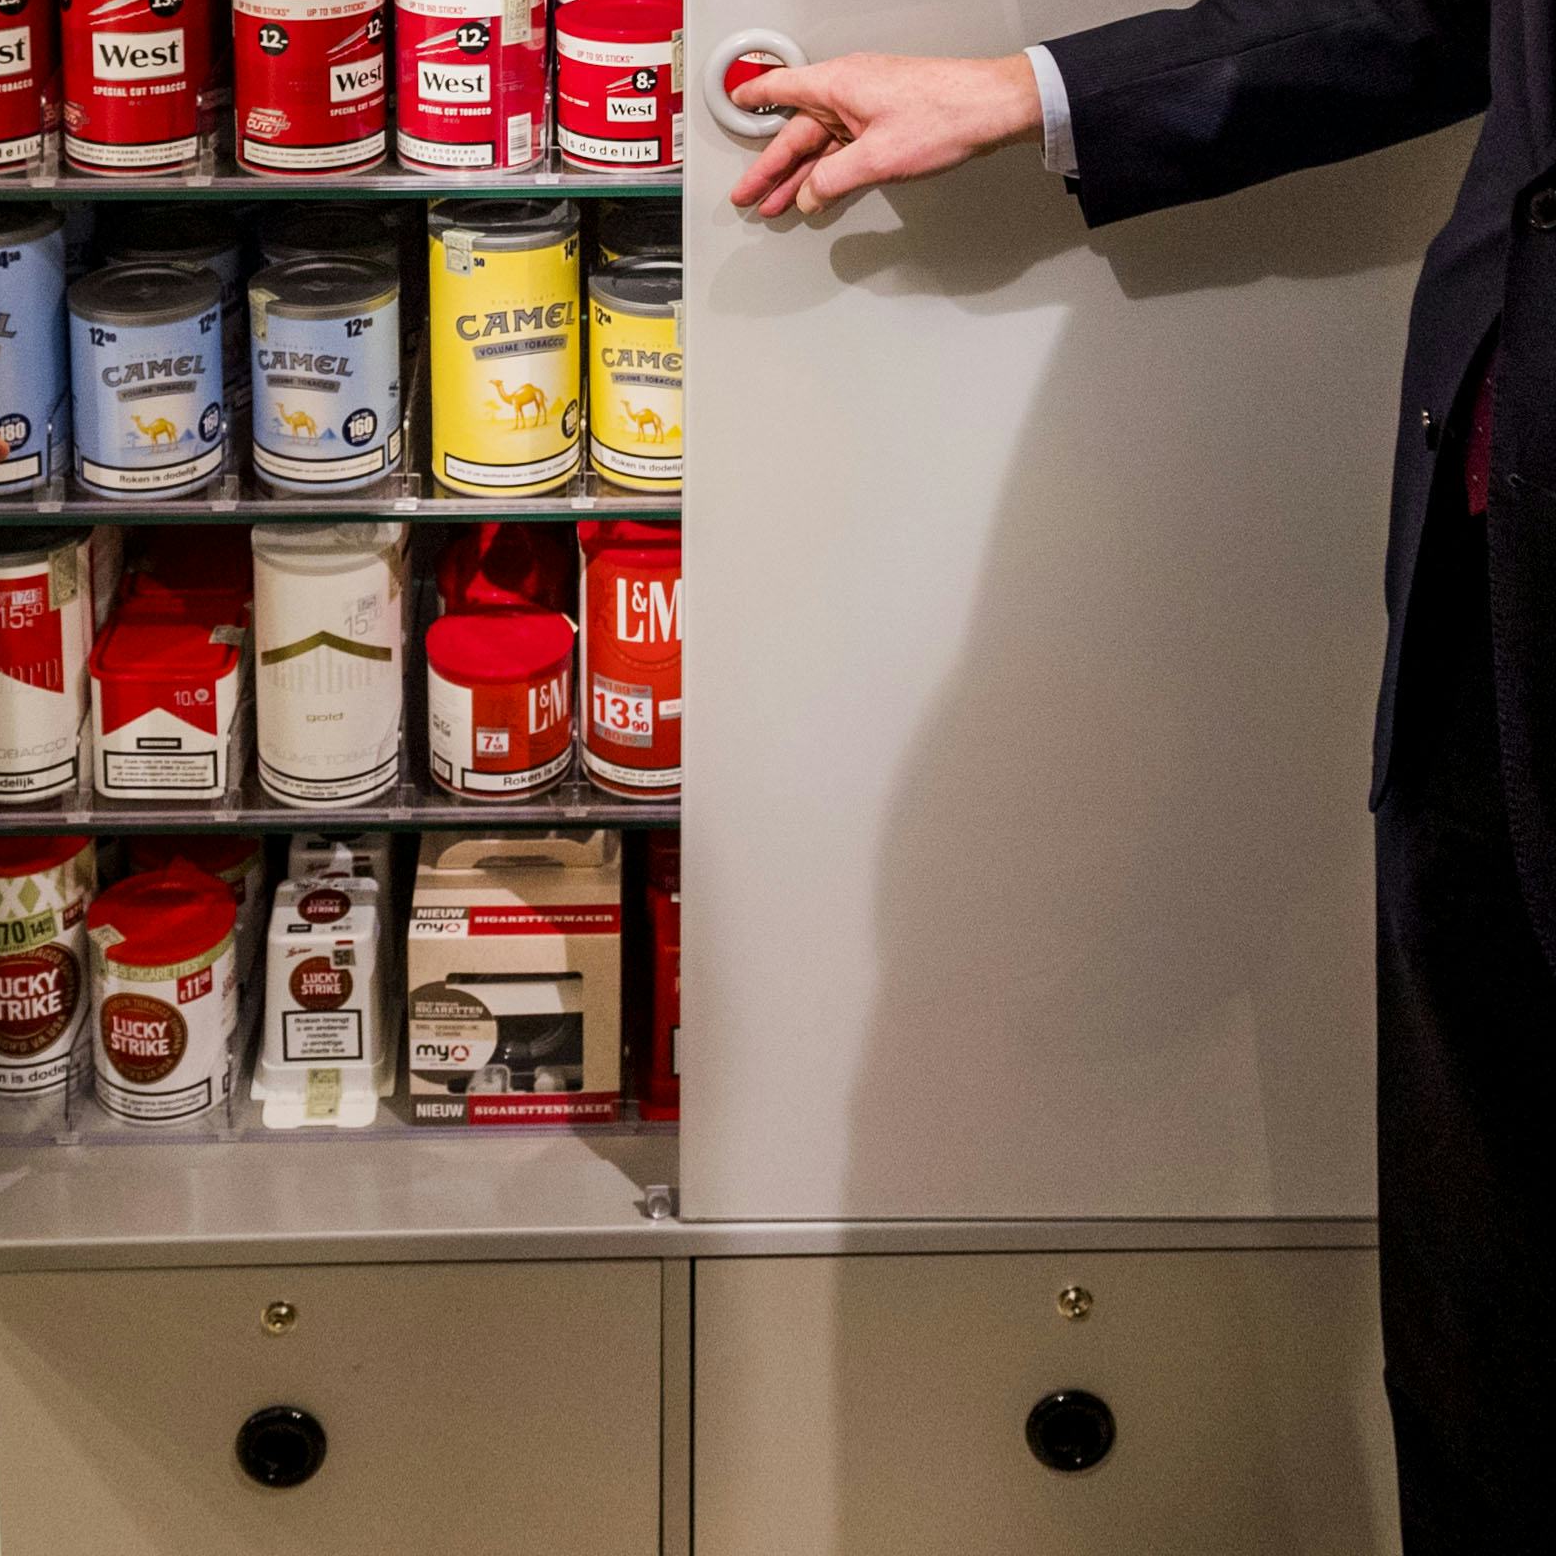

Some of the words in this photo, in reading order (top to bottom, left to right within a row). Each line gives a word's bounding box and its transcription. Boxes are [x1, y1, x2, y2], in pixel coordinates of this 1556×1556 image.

[98, 40, 180, 69] West
[335, 62, 383, 93] West
[422, 69, 485, 93] West
[611, 101, 653, 116] West
[455, 300, 577, 342] CAMEL
[478, 343, 519, 357] VOLUME
[524, 336, 565, 351] TOBACCO
[101, 353, 207, 388] CAMEL
[256, 348, 355, 378] CAMEL
[616, 576, 683, 644] L&M
[527, 669, 569, 736] L&M
[305, 711, 345, 723] gold
[416, 908, 465, 919] NIEUW
[474, 914, 614, 925] SIGARETTENMAKER
[300, 983, 342, 996] STRIKE
[302, 971, 342, 985] LUCKY
[112, 1015, 169, 1040] LUCKY
[110, 1033, 171, 1058] STRIKE
[415, 1103, 465, 1119] NIEUW
[474, 1104, 613, 1117] SIGARETTENMAKER
